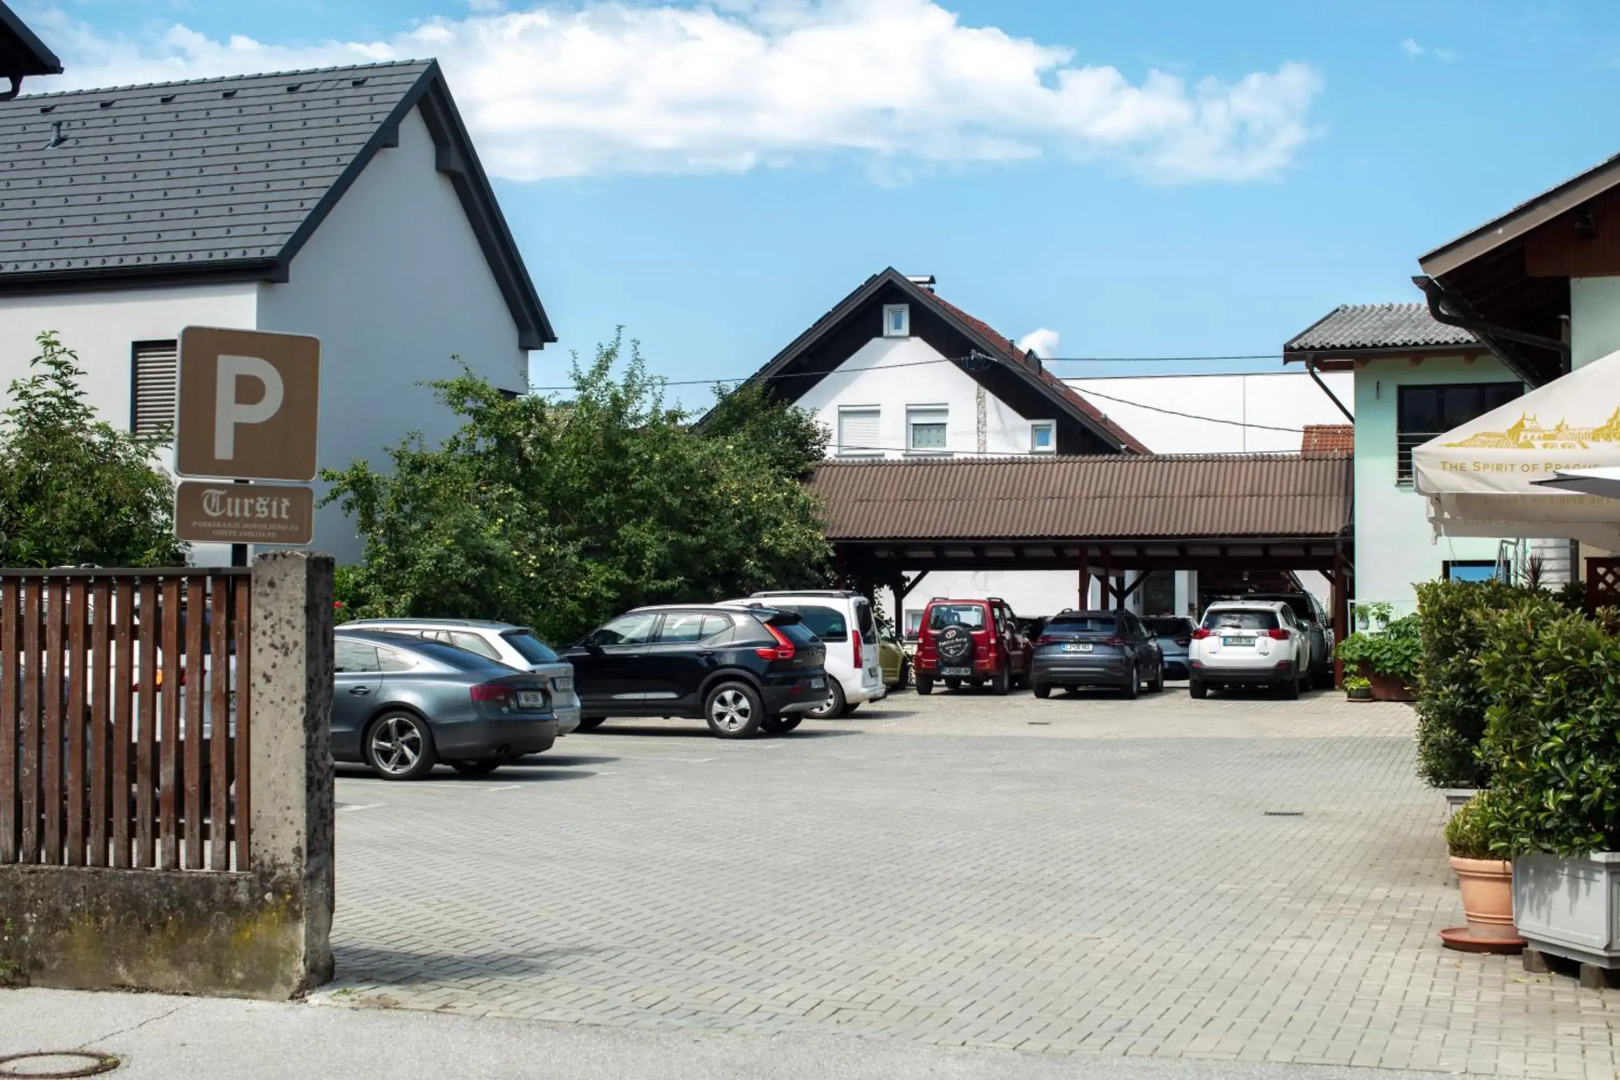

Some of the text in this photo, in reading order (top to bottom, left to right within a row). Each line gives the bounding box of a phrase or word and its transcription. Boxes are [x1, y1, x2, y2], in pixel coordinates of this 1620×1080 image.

[214, 354, 284, 461] P
[1440, 460, 1467, 472] THE
[1473, 462, 1515, 473] SPIRIT
[1521, 463, 1539, 473] OF
